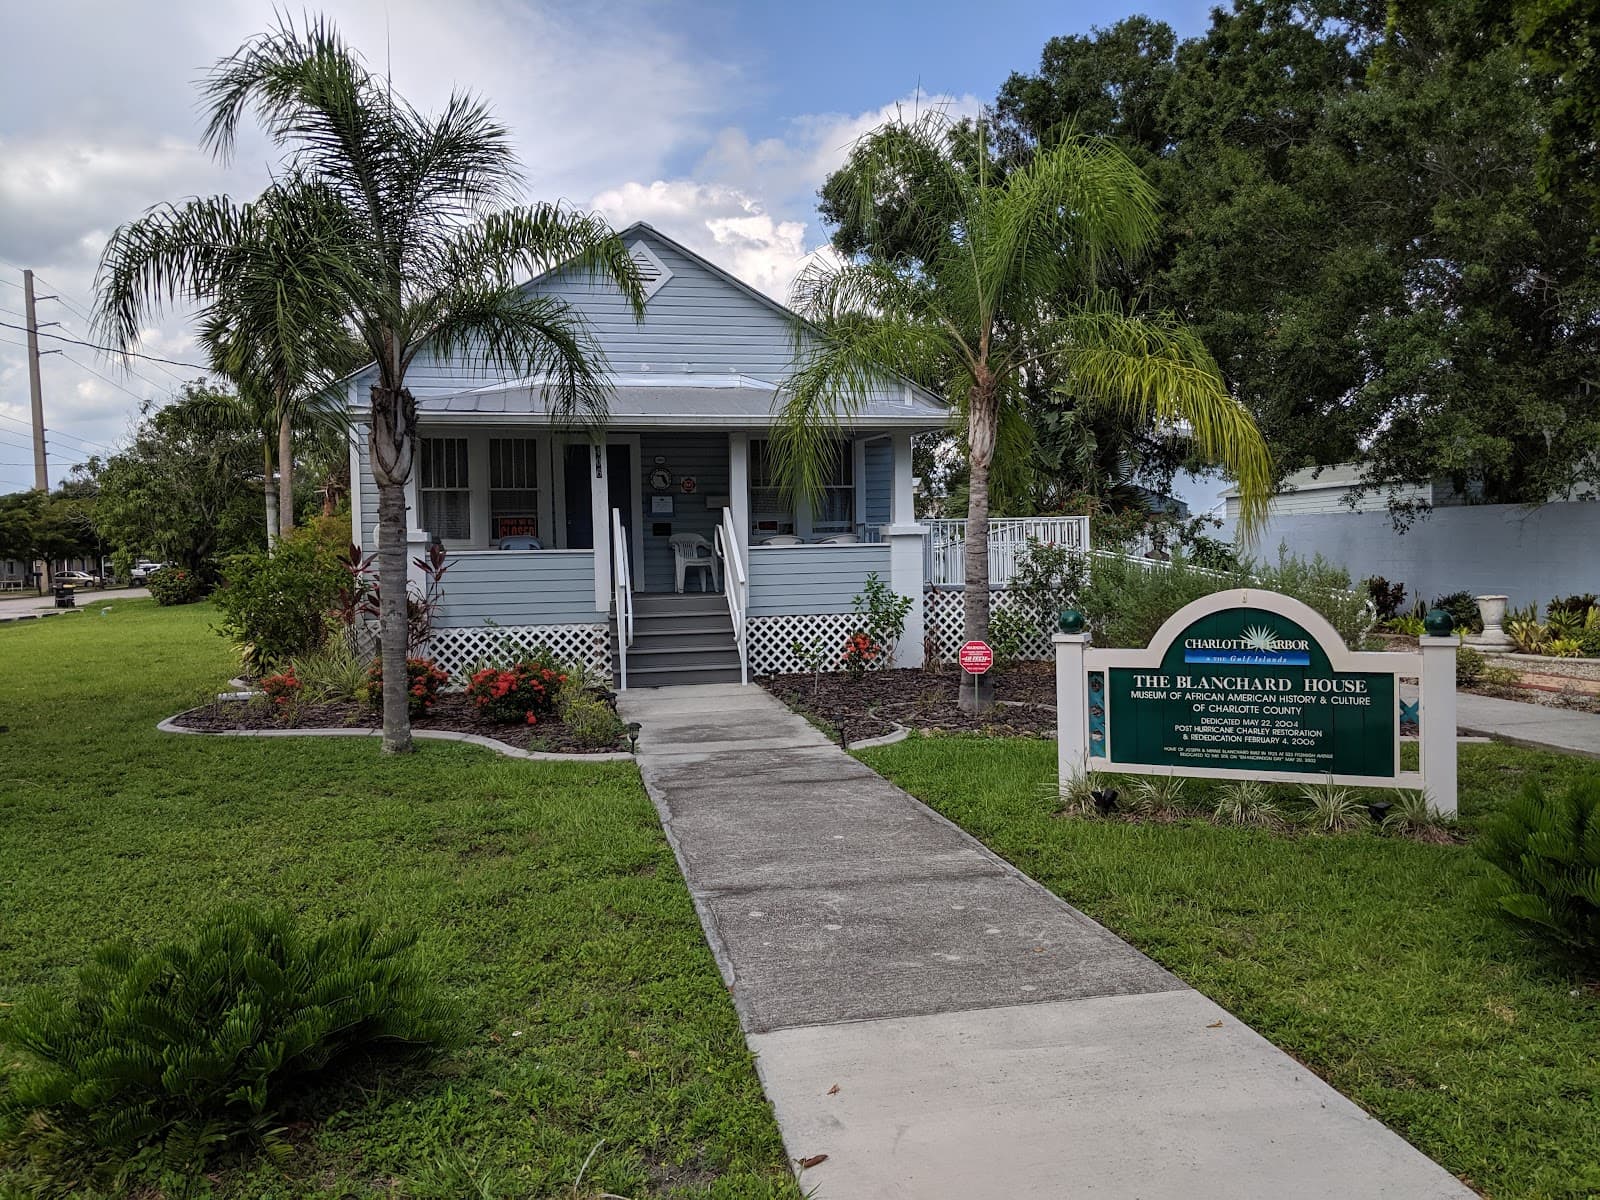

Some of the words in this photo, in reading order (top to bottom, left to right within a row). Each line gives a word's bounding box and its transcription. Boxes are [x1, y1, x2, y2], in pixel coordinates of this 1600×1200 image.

[1230, 655, 1251, 664] Gulf
[1133, 675, 1171, 688] THE
[1176, 675, 1292, 691] BLANCHARD
[1304, 679, 1367, 693] HOUSE
[1131, 690, 1167, 699] MUSEUM
[1170, 692, 1182, 700] OF
[1185, 692, 1225, 701] AFRICAN
[1227, 693, 1276, 702] AMERICAN
[1280, 695, 1317, 704] HISTORY
[1320, 696, 1327, 705] &
[1331, 696, 1371, 706] CULTURE
[1193, 703, 1206, 712] OF
[1209, 704, 1260, 714] CHARLOTTE
[1263, 706, 1302, 716] COUNTY
[1201, 717, 1241, 725] DEDICATED
[1243, 718, 1260, 726] MAY
[1275, 720, 1299, 728] 2004
[1175, 724, 1193, 732] POST
[1194, 725, 1234, 734] HURRICANE
[1236, 727, 1271, 736] CHARLEY
[1272, 729, 1323, 738] RESTORATION
[1191, 733, 1242, 743] REDEDICATION
[1244, 736, 1280, 744] FEBRUARY
[1291, 738, 1316, 746] 2006
